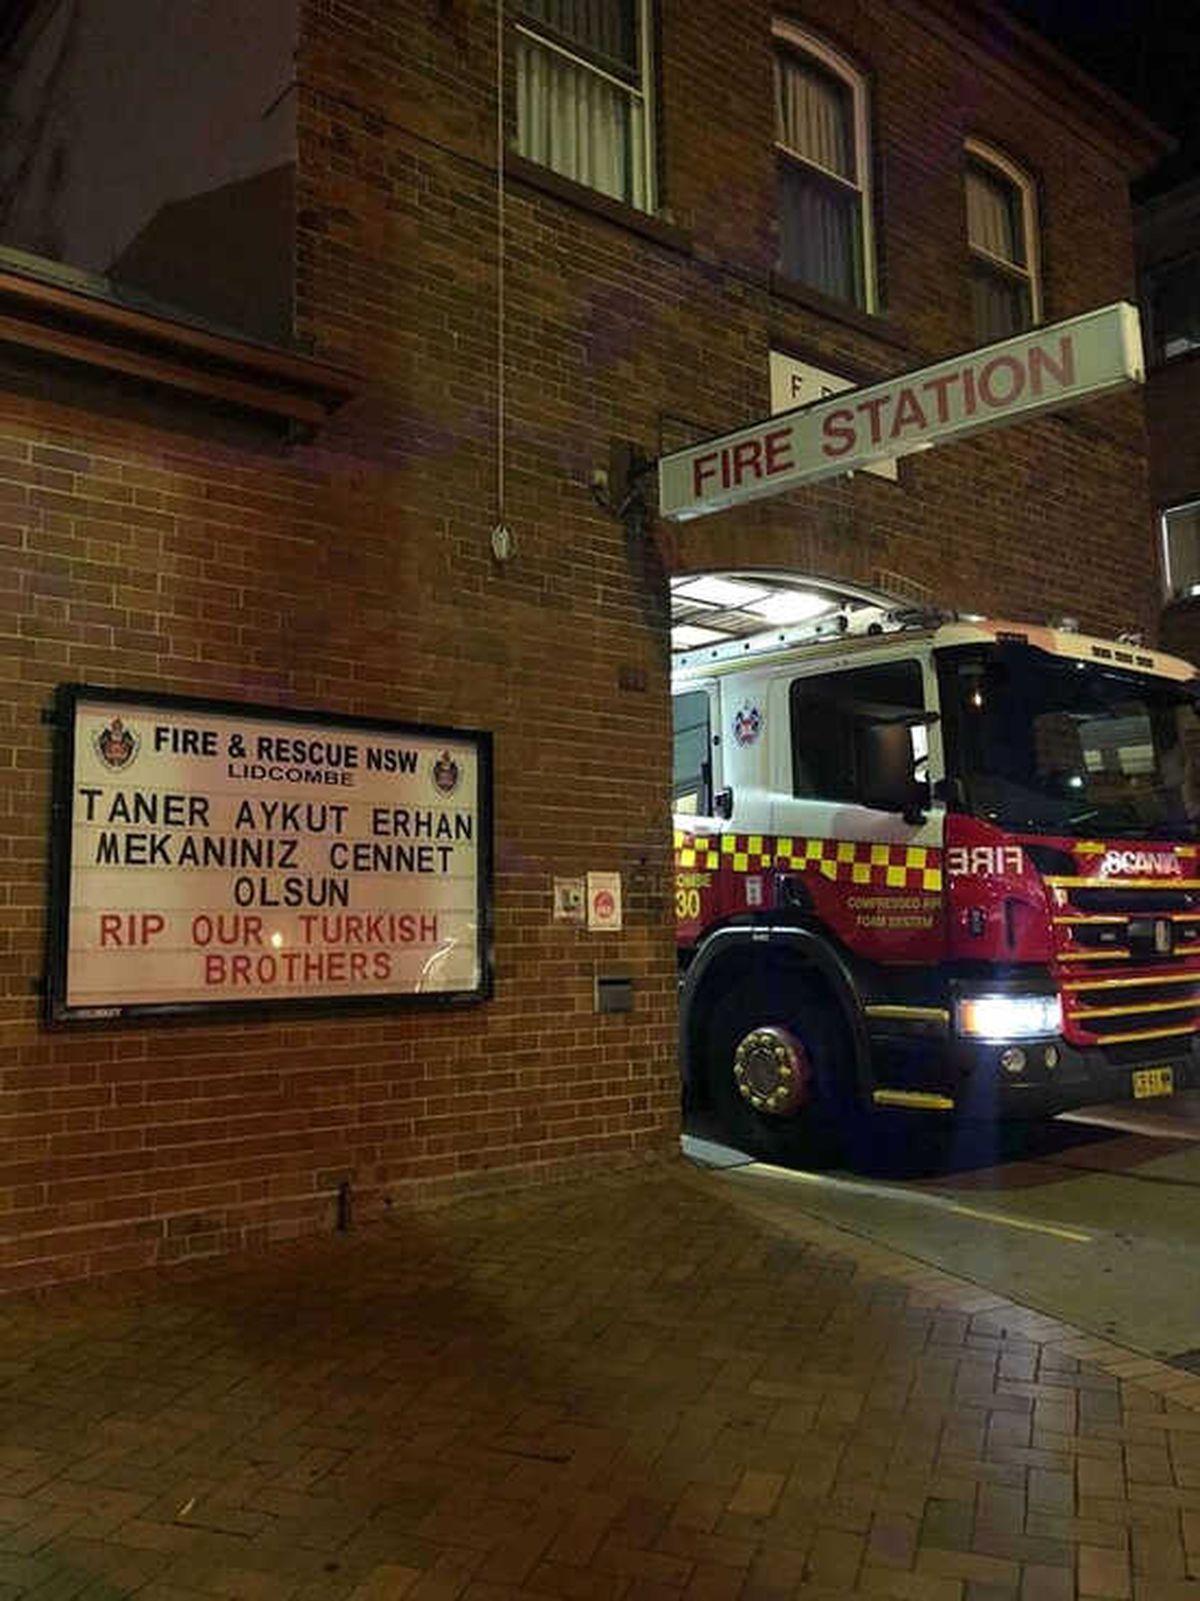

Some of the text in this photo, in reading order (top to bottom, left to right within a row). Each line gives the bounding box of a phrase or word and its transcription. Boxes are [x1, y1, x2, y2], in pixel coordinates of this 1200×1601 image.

[693, 336, 1077, 498] FIRE STATION
[154, 727, 419, 774] FIRE & RESCUE NSW
[228, 764, 356, 787] LIDCOMBE
[80, 789, 473, 840] TANER AYKUT ERHAN
[96, 833, 453, 873] MEKANINIZ CENNET
[1104, 850, 1182, 874] SCANIA
[234, 877, 349, 907] OLSUN
[676, 889, 700, 919] 30
[100, 914, 439, 947] RIP OUR TURKISH
[205, 952, 392, 985] BROTHERS
